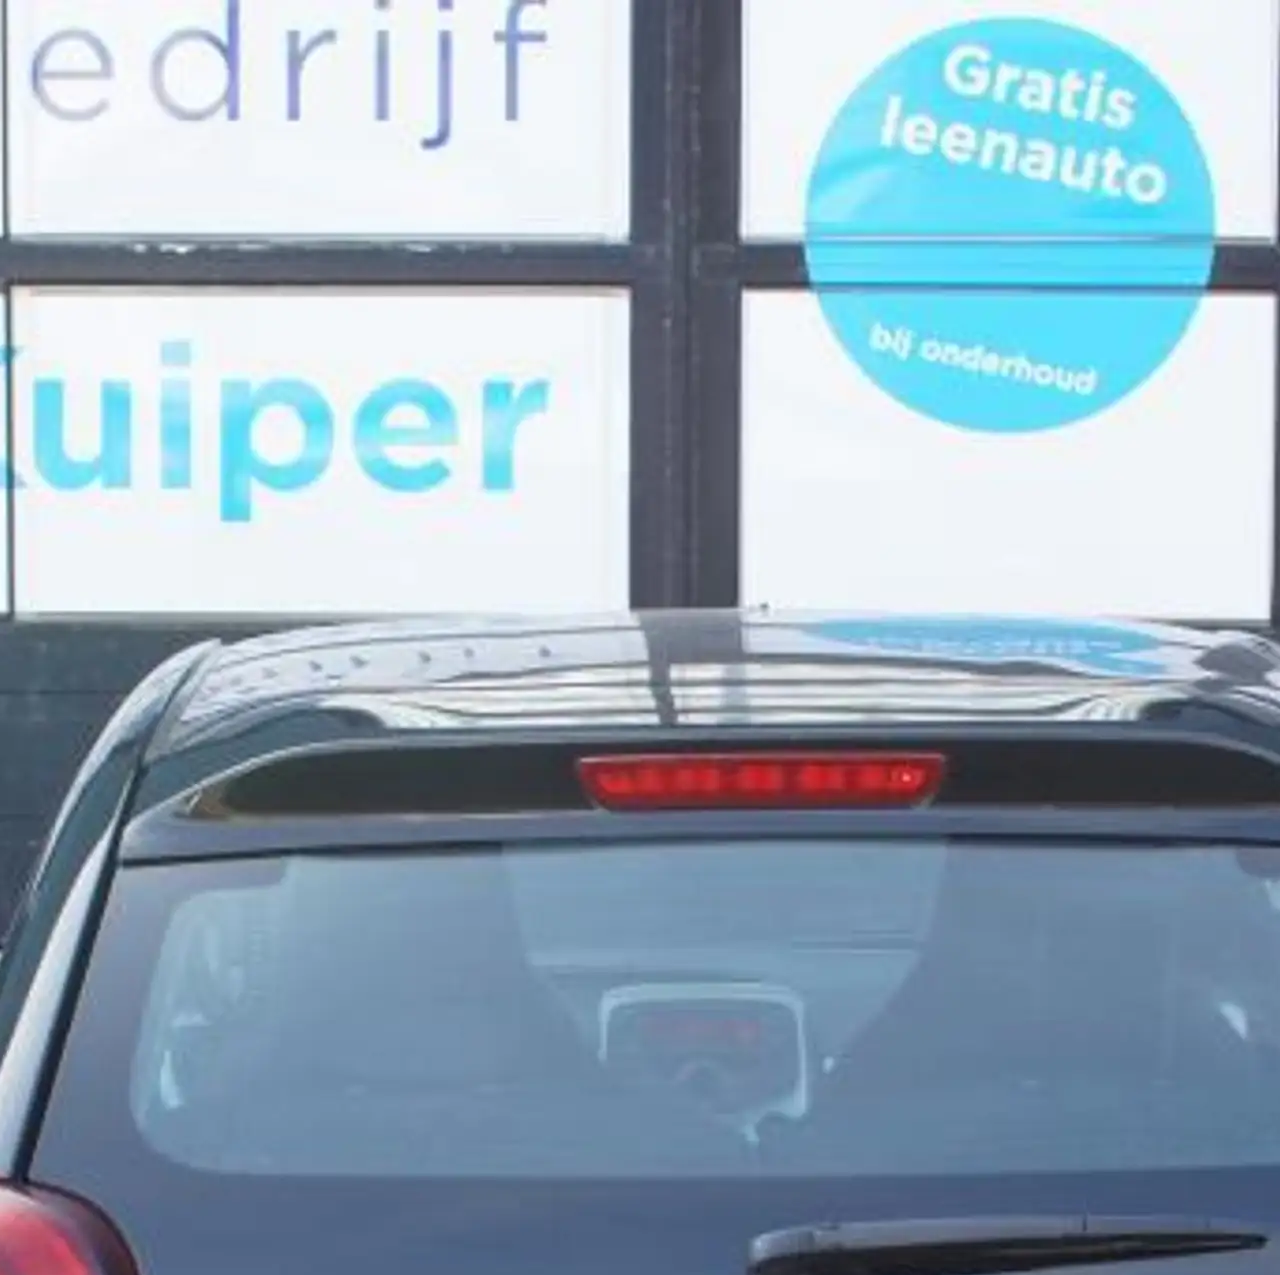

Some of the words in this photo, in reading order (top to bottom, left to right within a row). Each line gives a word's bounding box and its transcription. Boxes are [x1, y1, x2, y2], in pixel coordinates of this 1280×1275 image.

[942, 44, 1136, 129] Gratis
[879, 96, 1167, 205] leenauto
[869, 322, 915, 358] bij
[920, 336, 1098, 396] onderhoud
